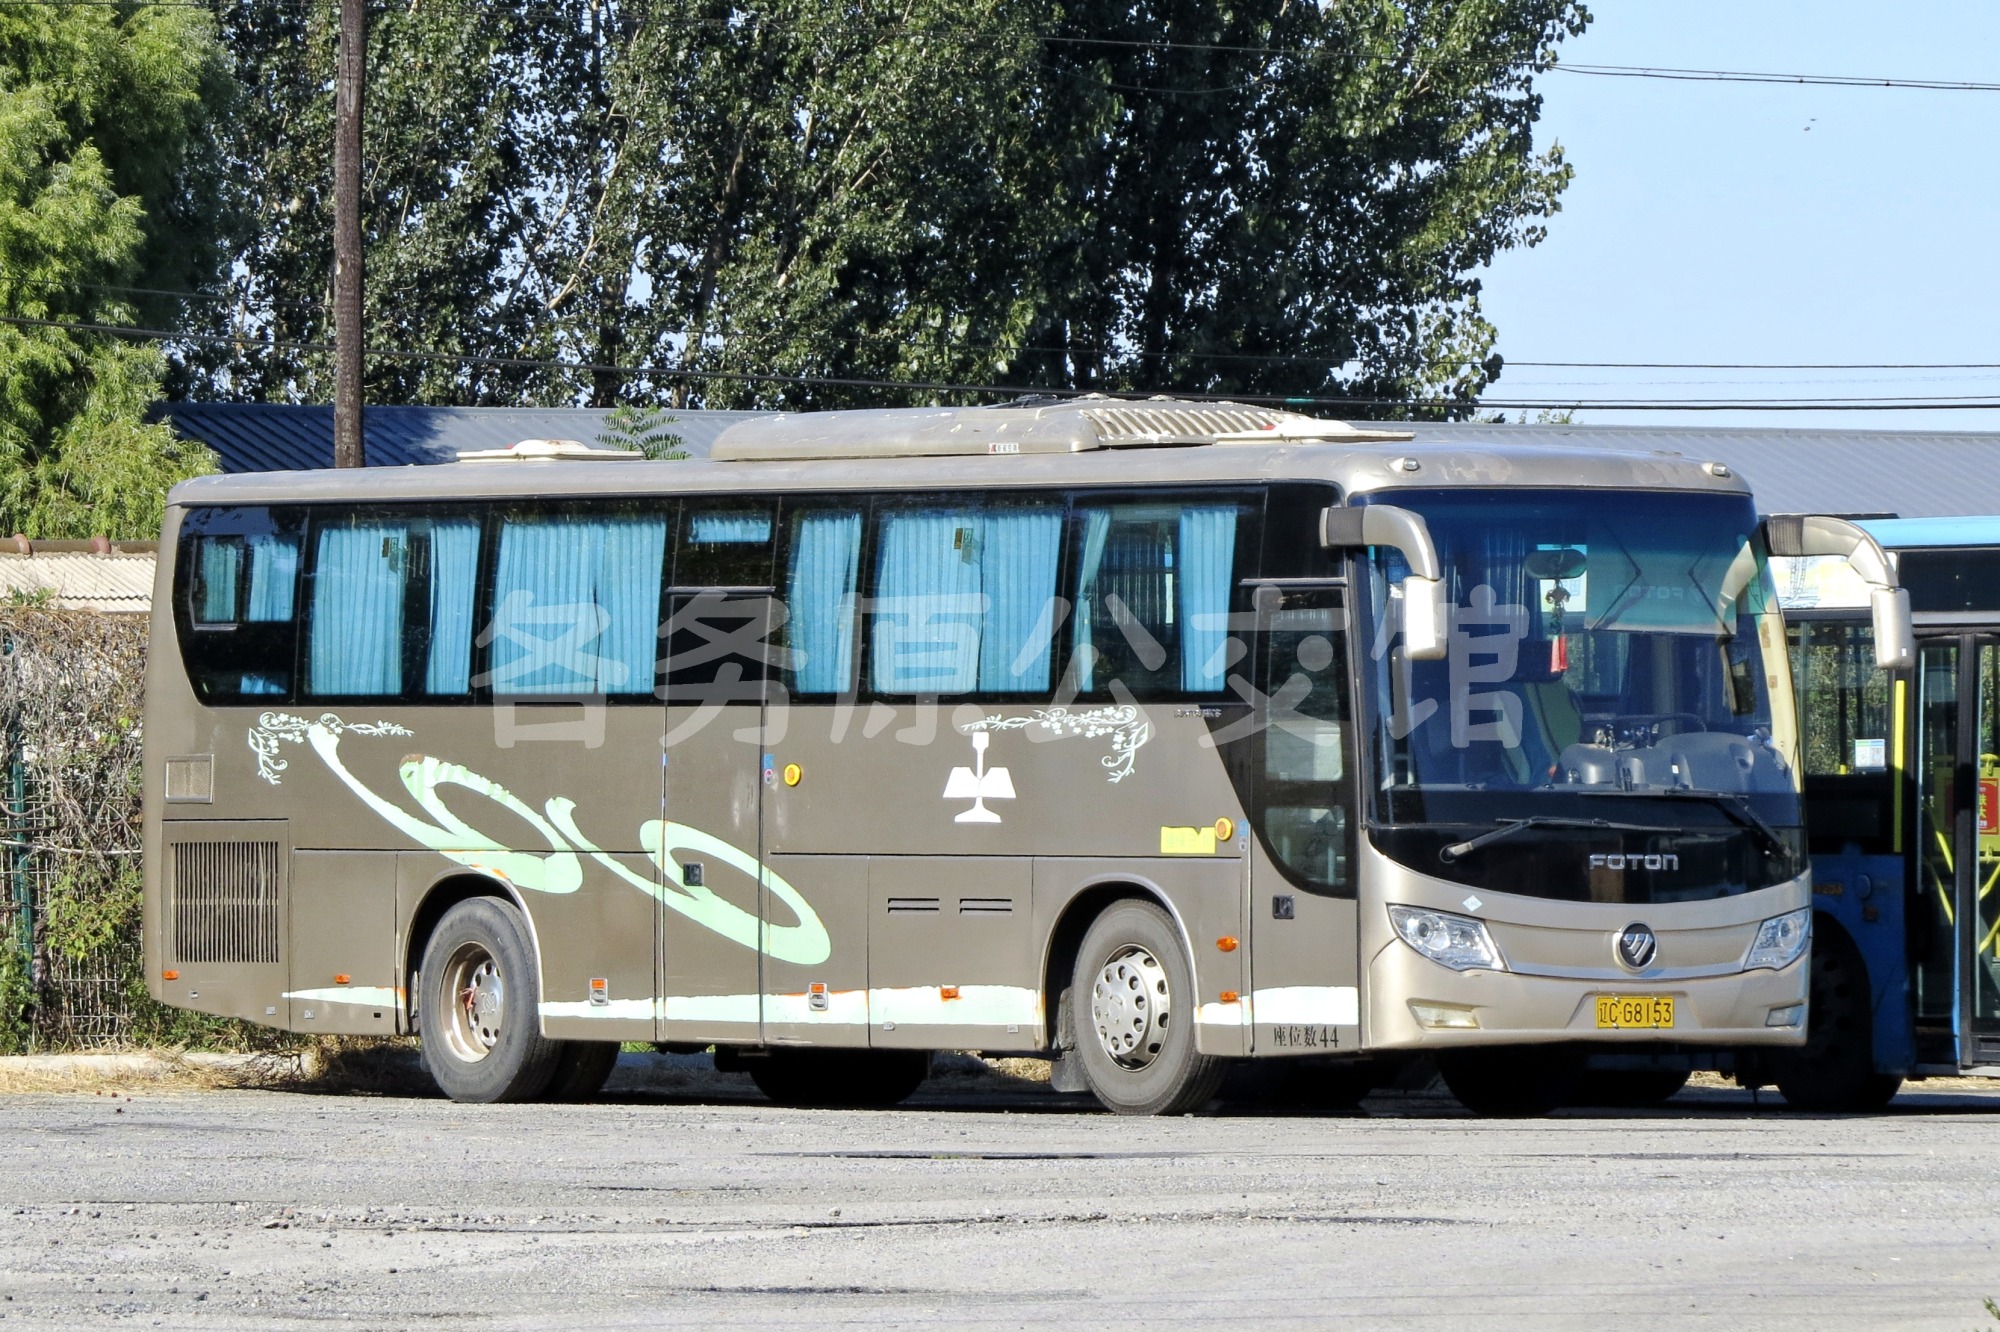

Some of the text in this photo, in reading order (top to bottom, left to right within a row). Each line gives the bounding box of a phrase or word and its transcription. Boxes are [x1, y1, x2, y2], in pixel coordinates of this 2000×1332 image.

[1589, 854, 1679, 870] FOTON
[1274, 1025, 1339, 1048] 座位数44
